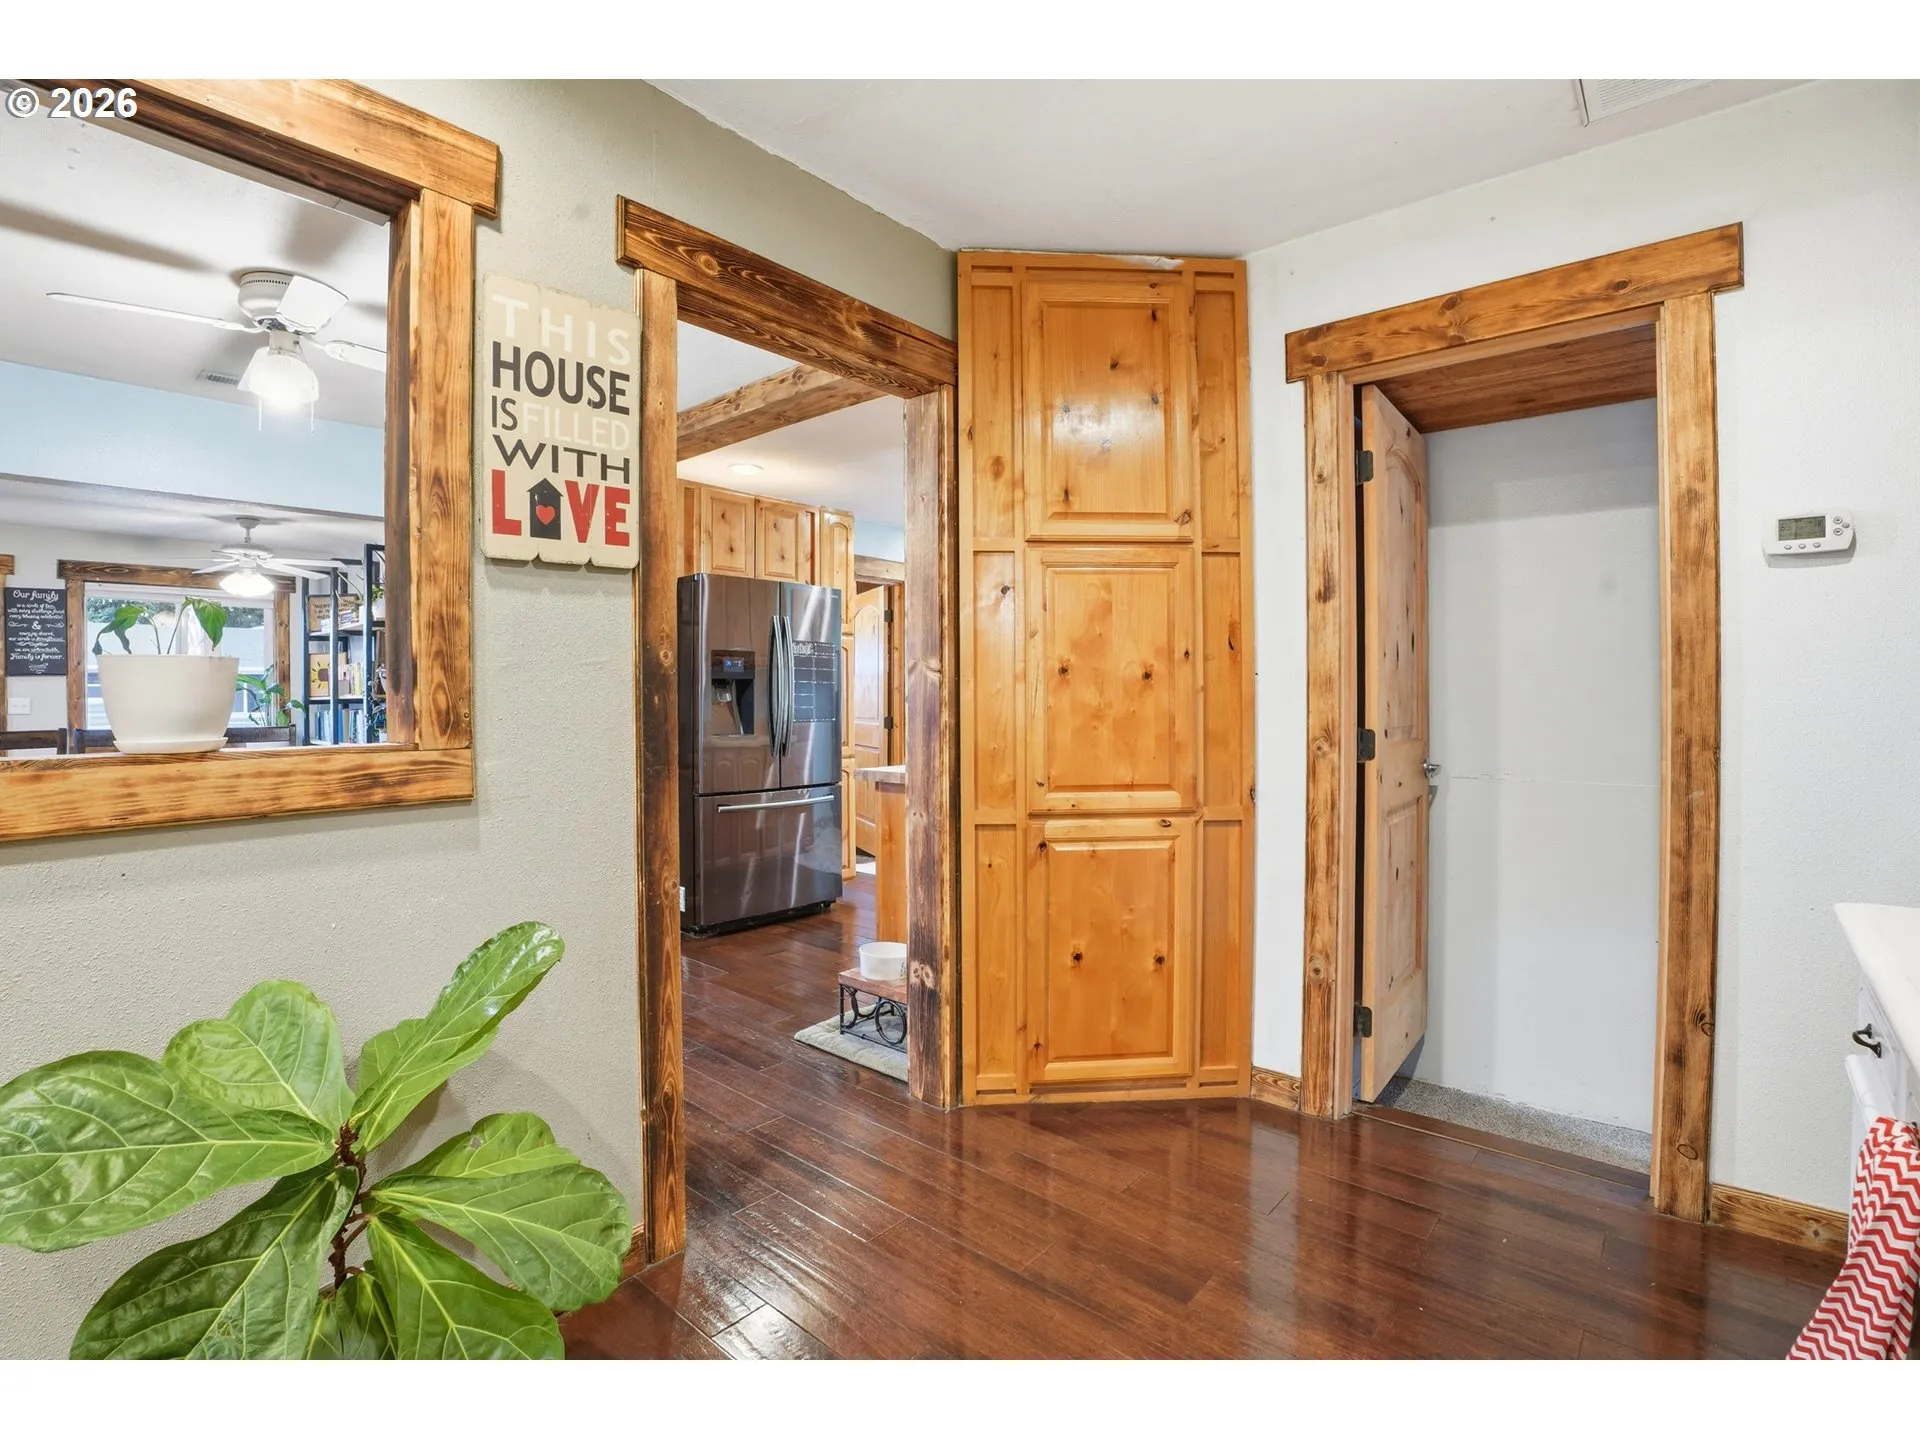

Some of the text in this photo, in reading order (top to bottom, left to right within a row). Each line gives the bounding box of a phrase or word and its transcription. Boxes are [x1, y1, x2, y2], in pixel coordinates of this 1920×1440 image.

[492, 295, 630, 367] THIS
[492, 340, 630, 416] HOUSE
[491, 395, 630, 451] IS FILLED
[492, 434, 630, 484] WITH
[491, 469, 631, 547] LVE
[13, 589, 30, 598] Our
[10, 652, 34, 661] Family
